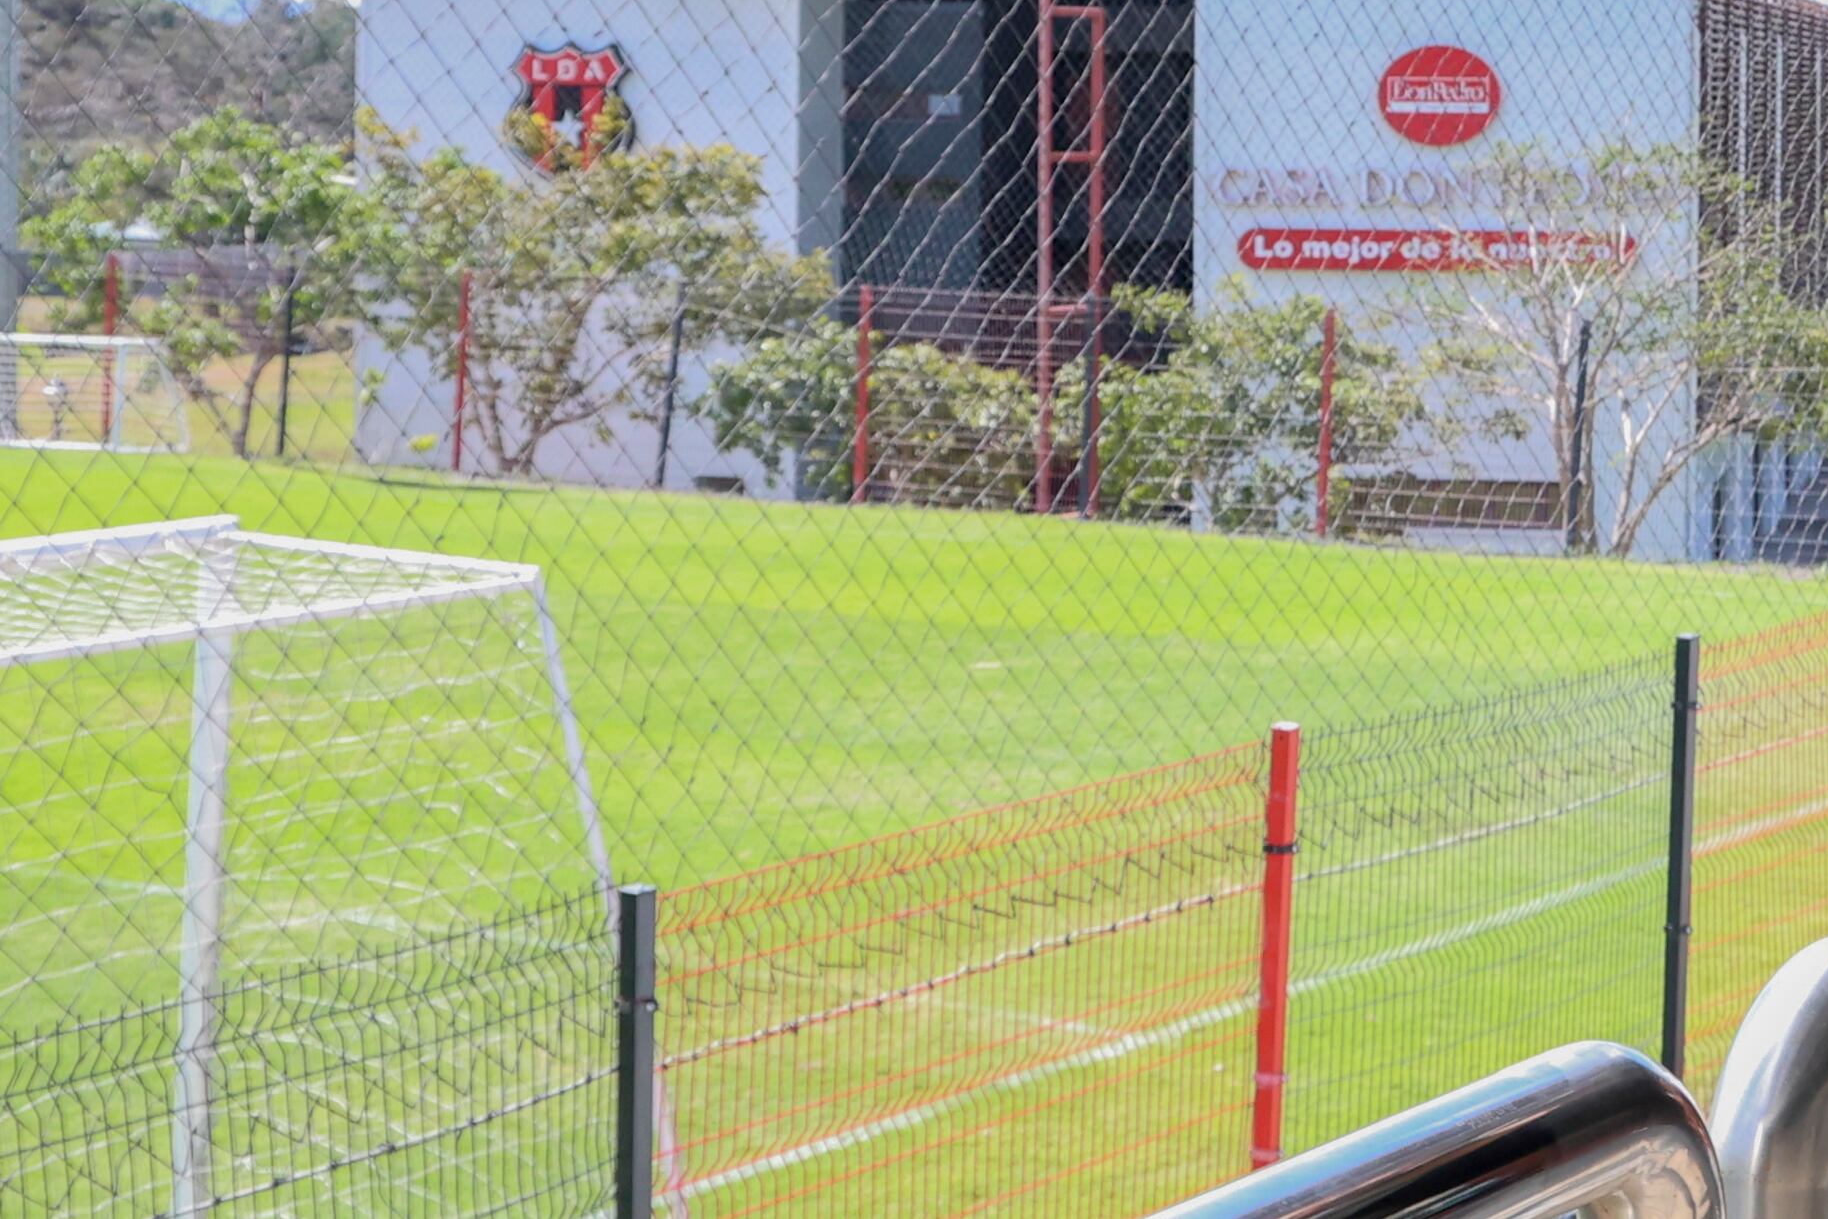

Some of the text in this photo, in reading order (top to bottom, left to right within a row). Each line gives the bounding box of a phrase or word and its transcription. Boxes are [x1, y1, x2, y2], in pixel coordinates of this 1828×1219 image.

[531, 58, 606, 81] LDA
[1215, 168, 1343, 207] CASA
[1360, 168, 1479, 207] DON
[1253, 235, 1294, 259] Lo
[1302, 236, 1394, 264] mejor
[1402, 237, 1442, 259] de
